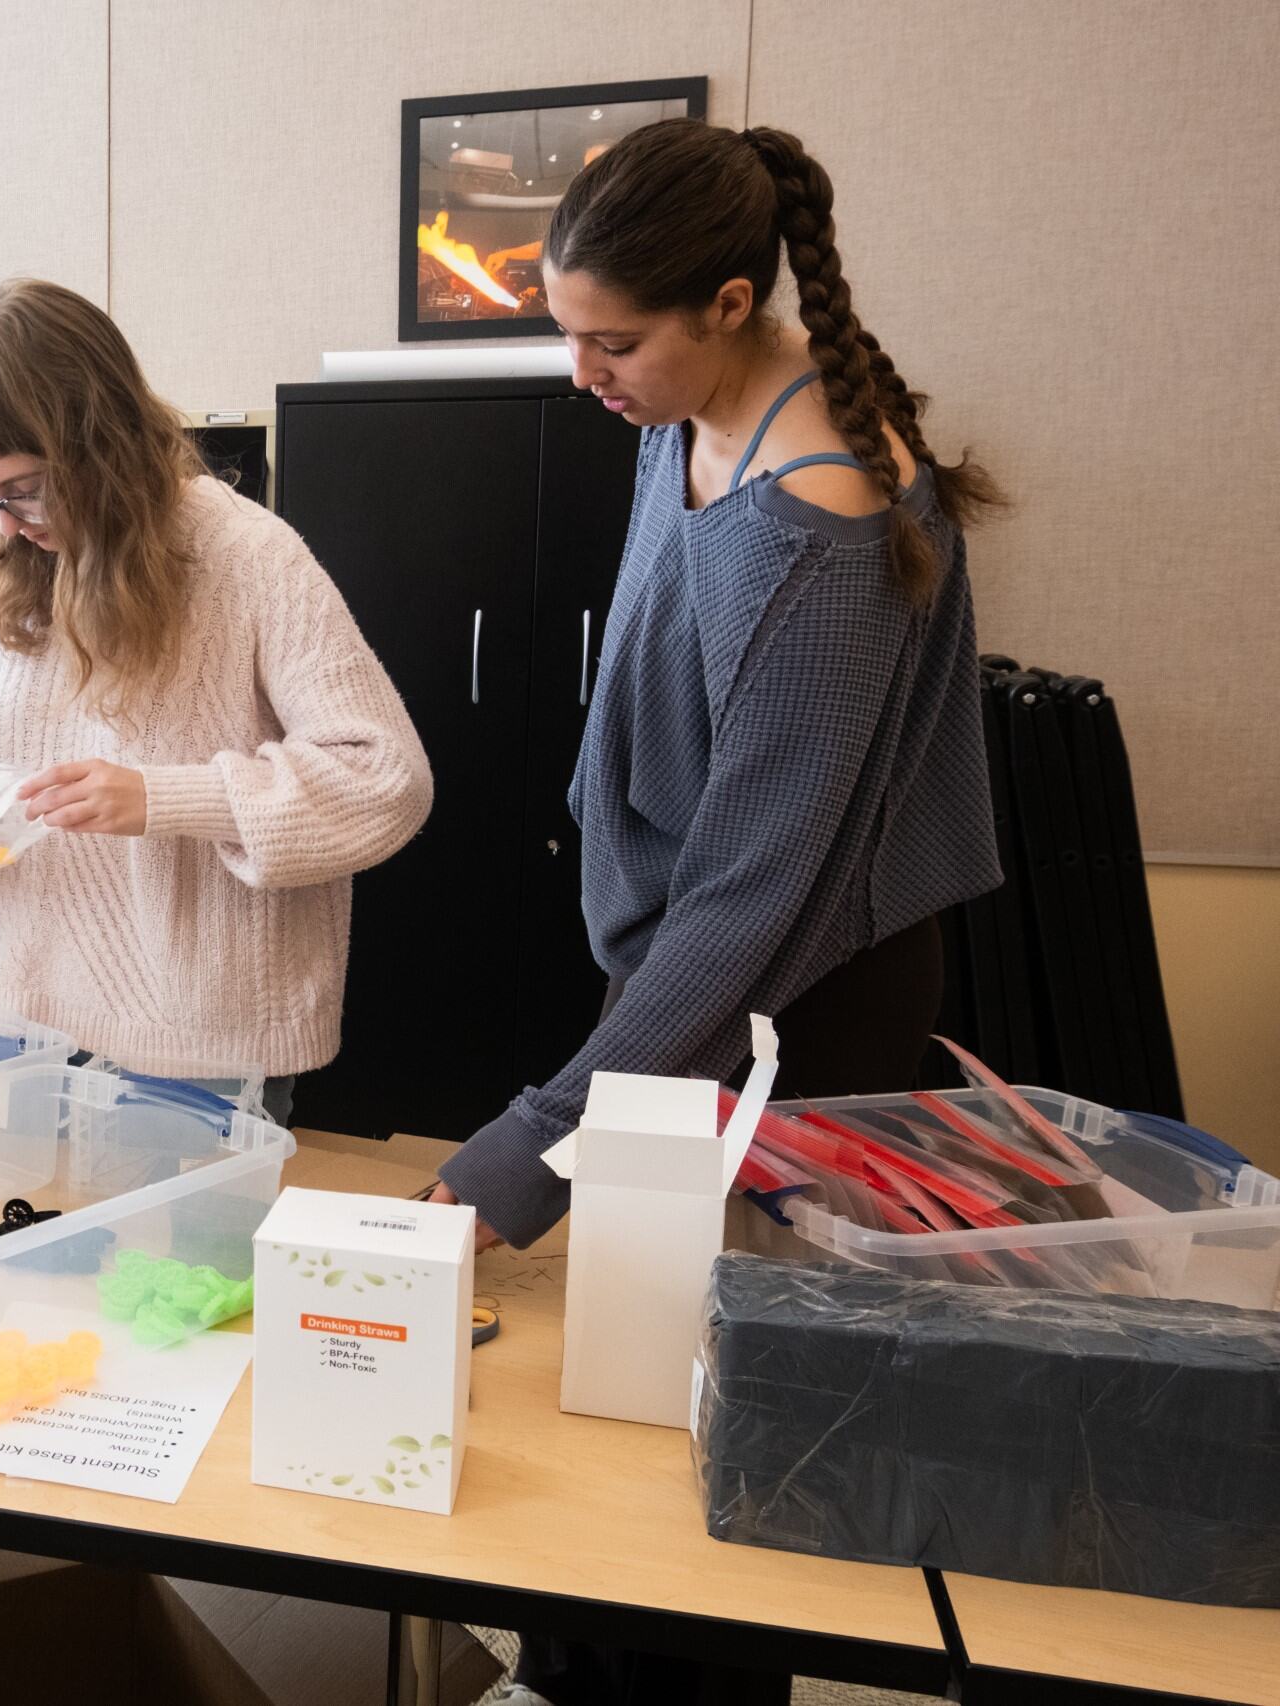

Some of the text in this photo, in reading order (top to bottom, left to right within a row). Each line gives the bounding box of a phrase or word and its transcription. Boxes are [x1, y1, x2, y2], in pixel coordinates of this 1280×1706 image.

[307, 1318, 400, 1339] Drinking Straws
[329, 1338, 361, 1349] Sturdy
[329, 1349, 376, 1363] BPA-Free
[329, 1360, 377, 1373] Non-Toxic
[91, 1391, 130, 1404] BOSS
[133, 1397, 148, 1408] of
[40, 1406, 55, 1417] (2
[151, 1399, 177, 1411] bag
[58, 1410, 75, 1421] kit
[126, 1408, 183, 1425] wheels)
[11, 1415, 79, 1434] rectangle
[78, 1413, 165, 1435] axel/wheels
[81, 1426, 157, 1445] cardboard
[28, 1448, 77, 1464] Base
[108, 1444, 150, 1458] straw
[81, 1456, 161, 1479] Student
